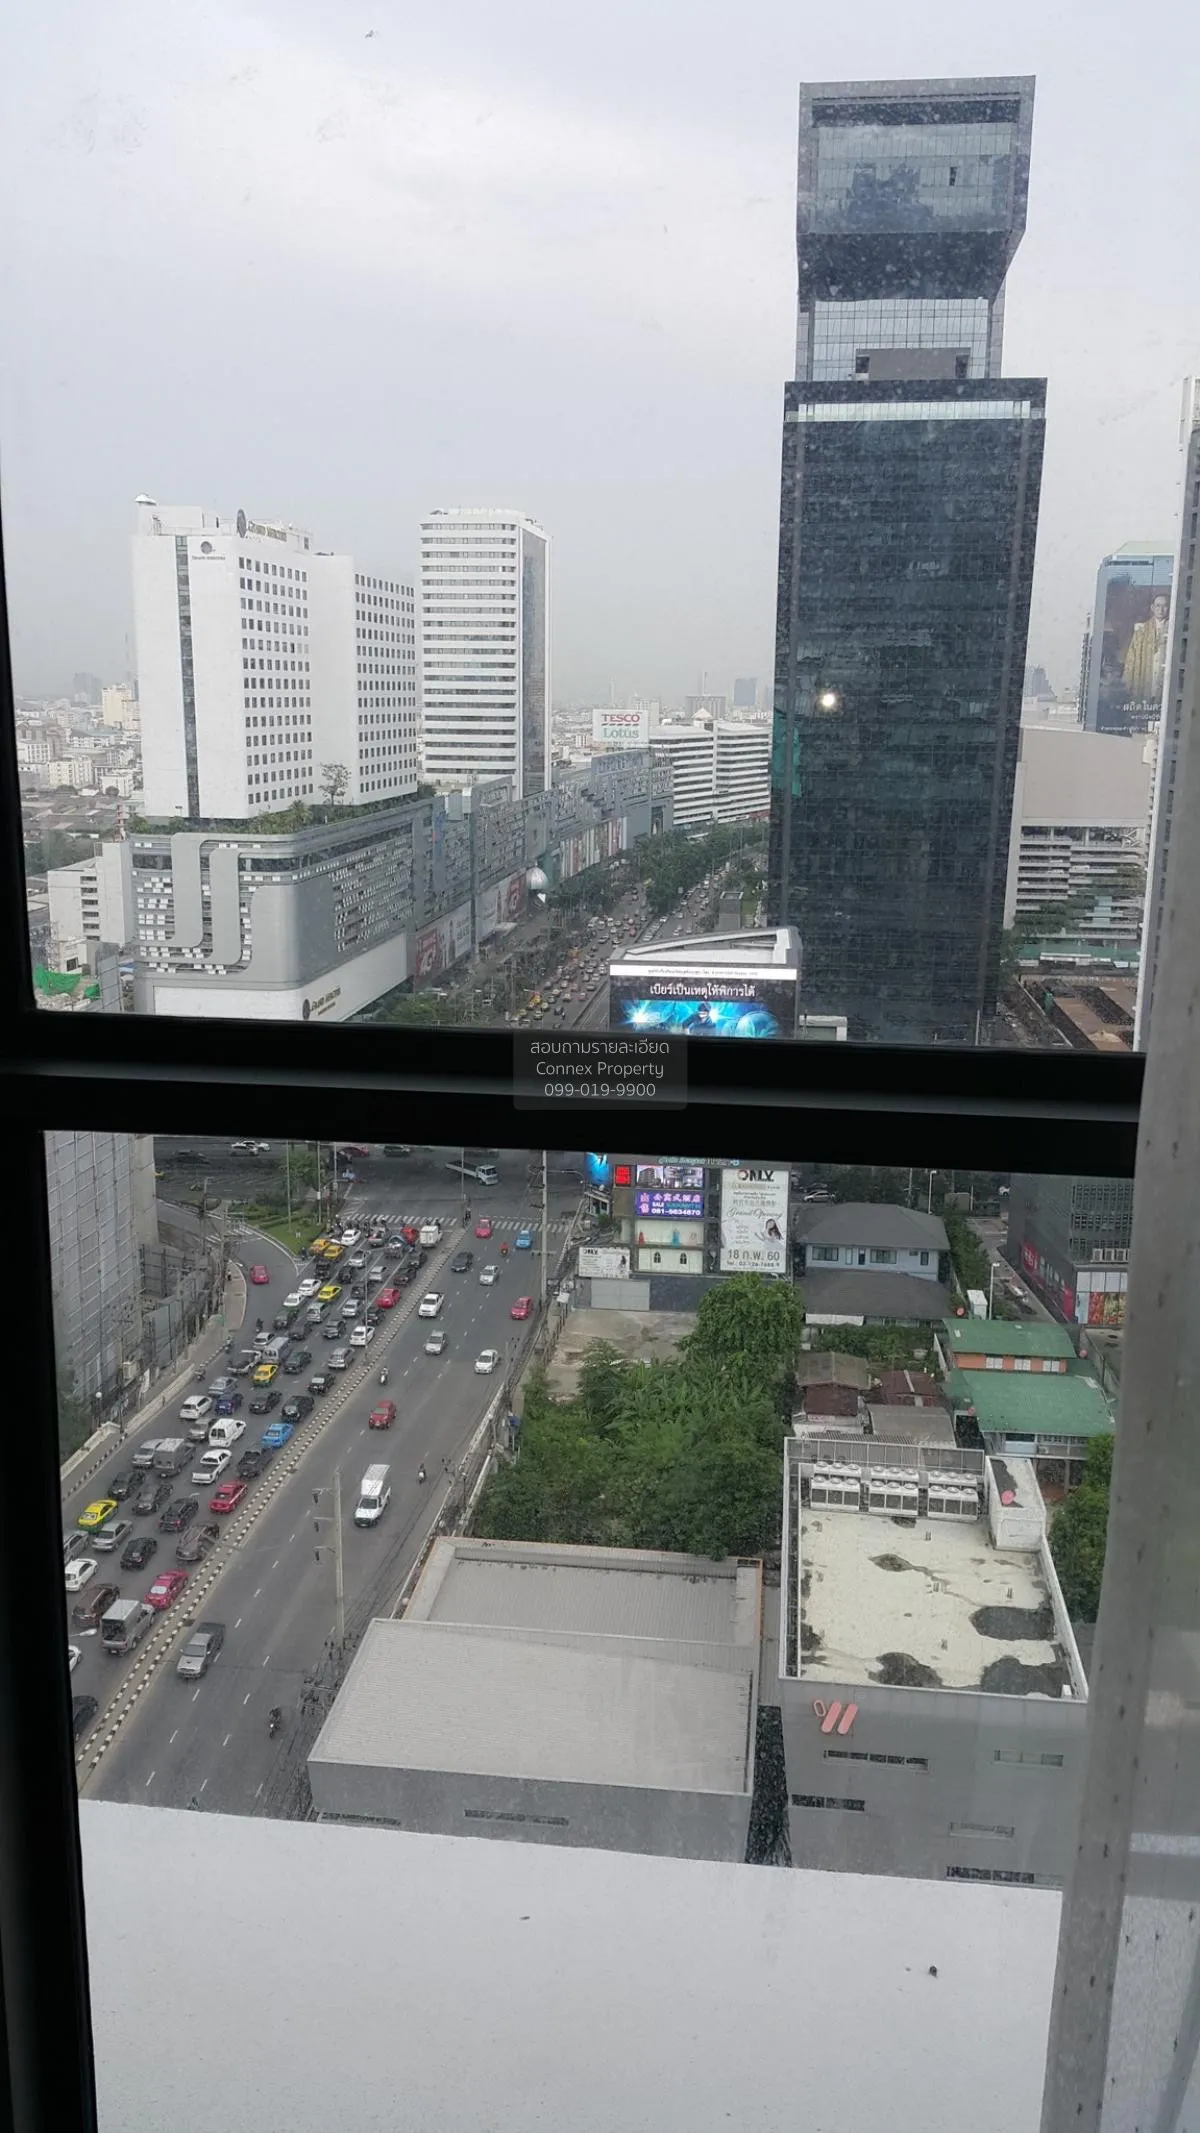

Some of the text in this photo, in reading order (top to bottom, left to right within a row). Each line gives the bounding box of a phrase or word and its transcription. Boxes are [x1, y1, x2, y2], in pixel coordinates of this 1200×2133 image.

[601, 713, 640, 723] TESCO
[602, 728, 640, 738] Lotus
[650, 982, 756, 999] เบียร์เป็นเหตุให้พิการได้
[738, 1169, 774, 1182] ONLY
[728, 1249, 740, 1260] 18
[767, 1251, 780, 1261] 60
